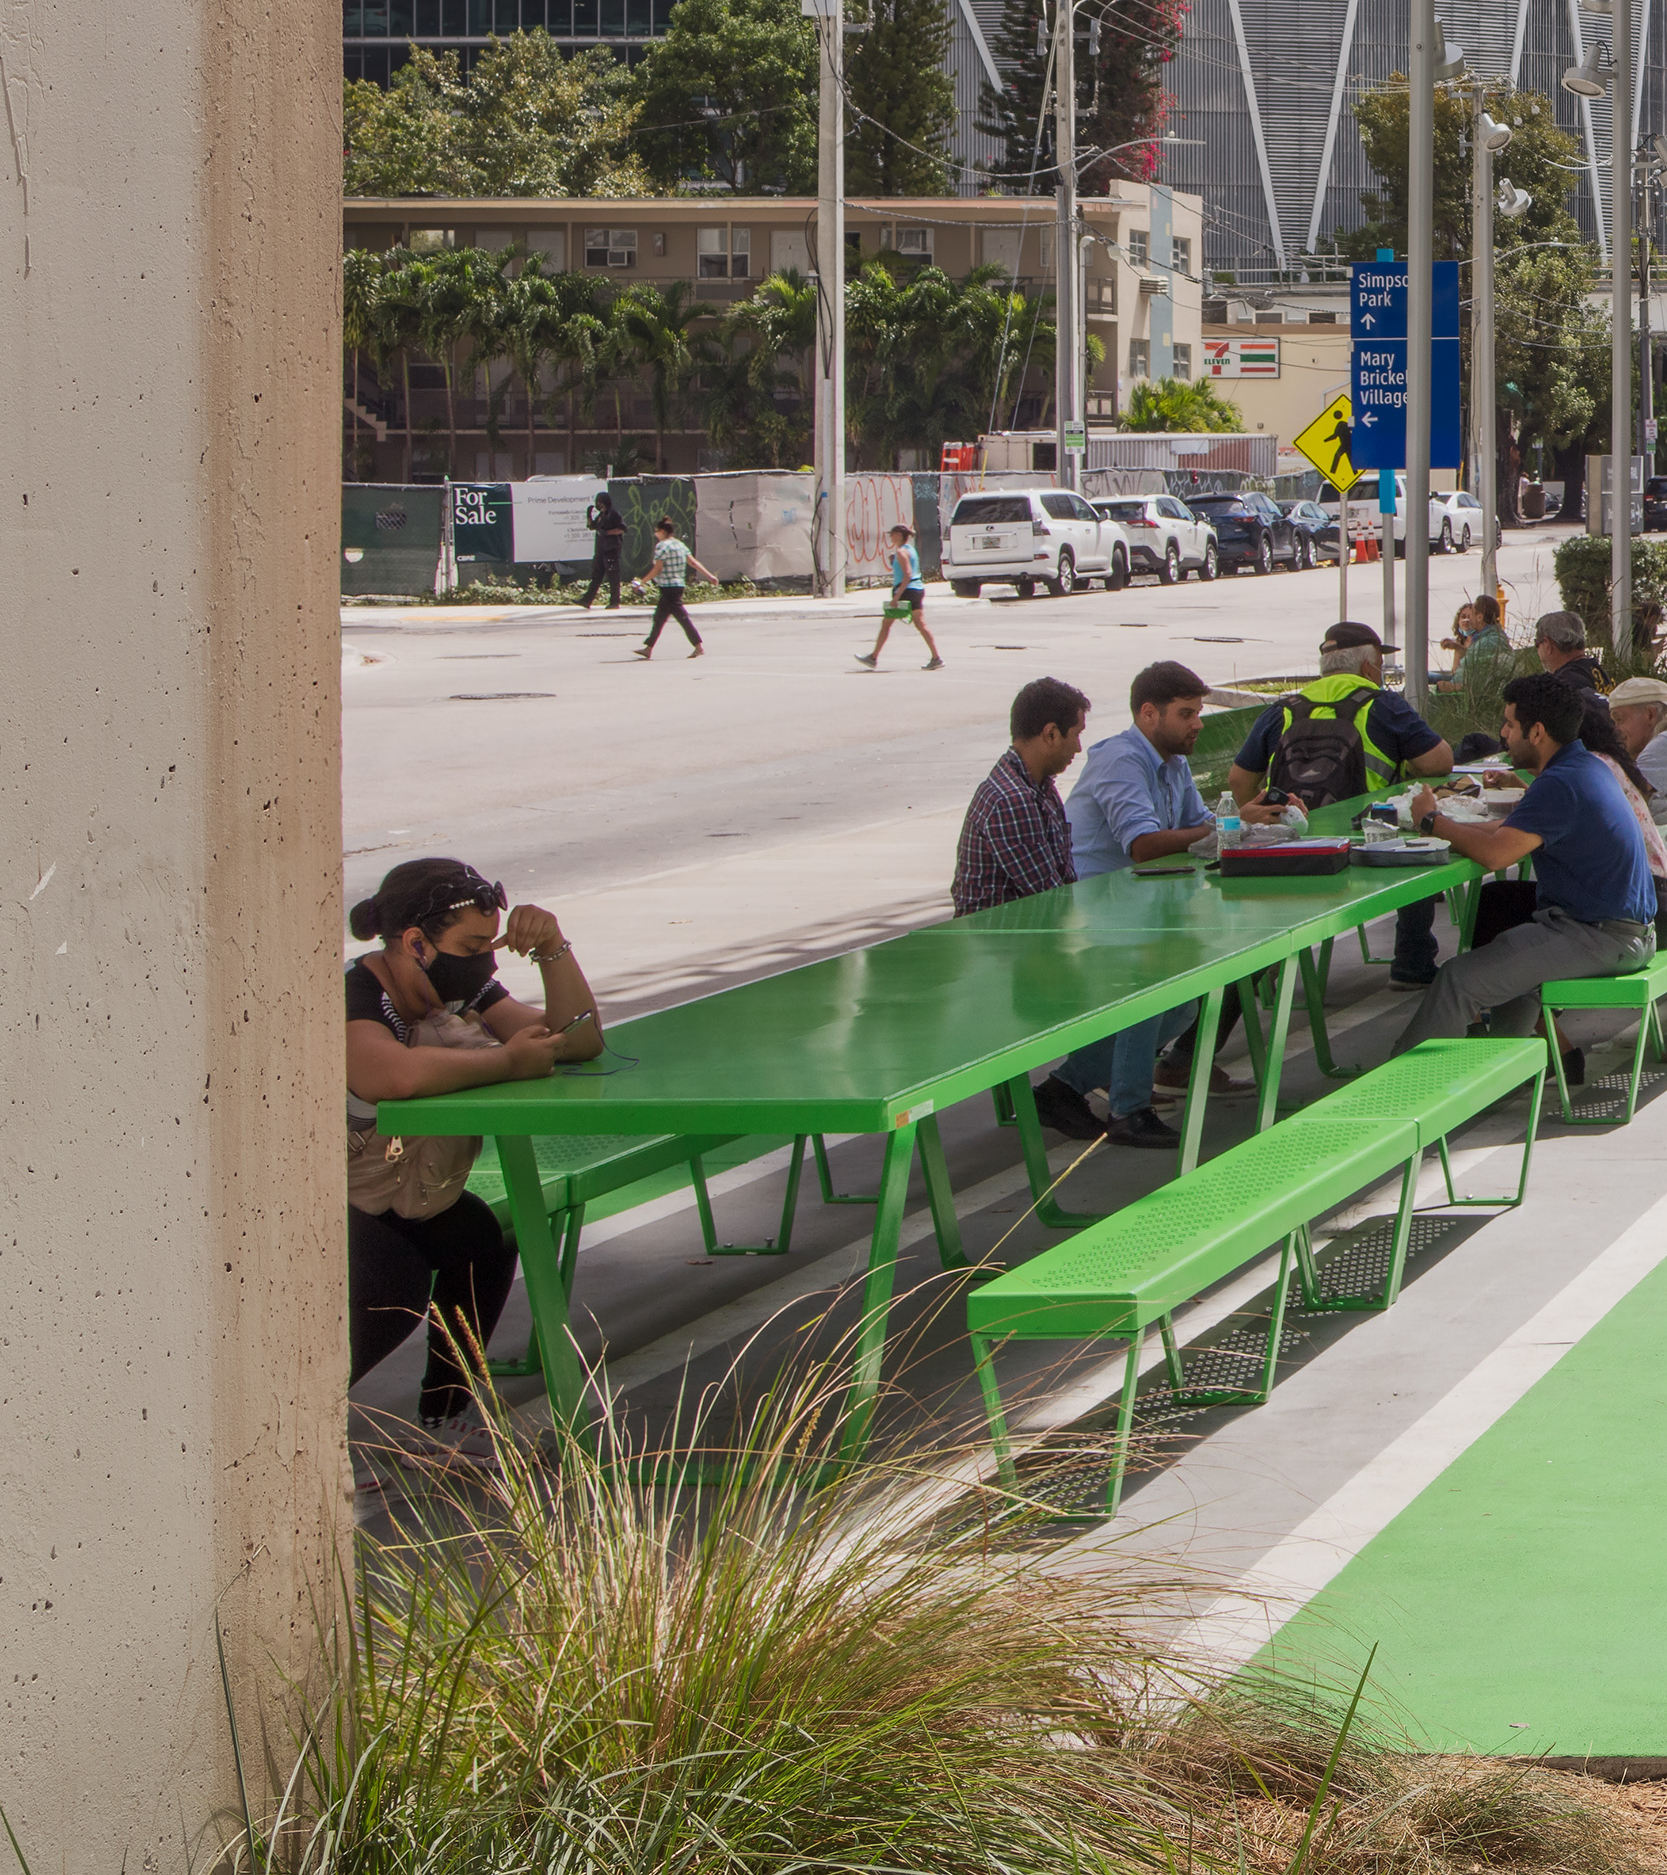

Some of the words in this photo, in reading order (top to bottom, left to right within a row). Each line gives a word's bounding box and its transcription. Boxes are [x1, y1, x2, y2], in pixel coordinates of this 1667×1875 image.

[1358, 272, 1408, 291] Simpso
[1359, 291, 1392, 306] Park
[1360, 351, 1395, 369] Mary
[1360, 369, 1408, 386] Brickel
[454, 487, 487, 506] For
[549, 495, 591, 504] Development
[455, 505, 497, 525] Sale
